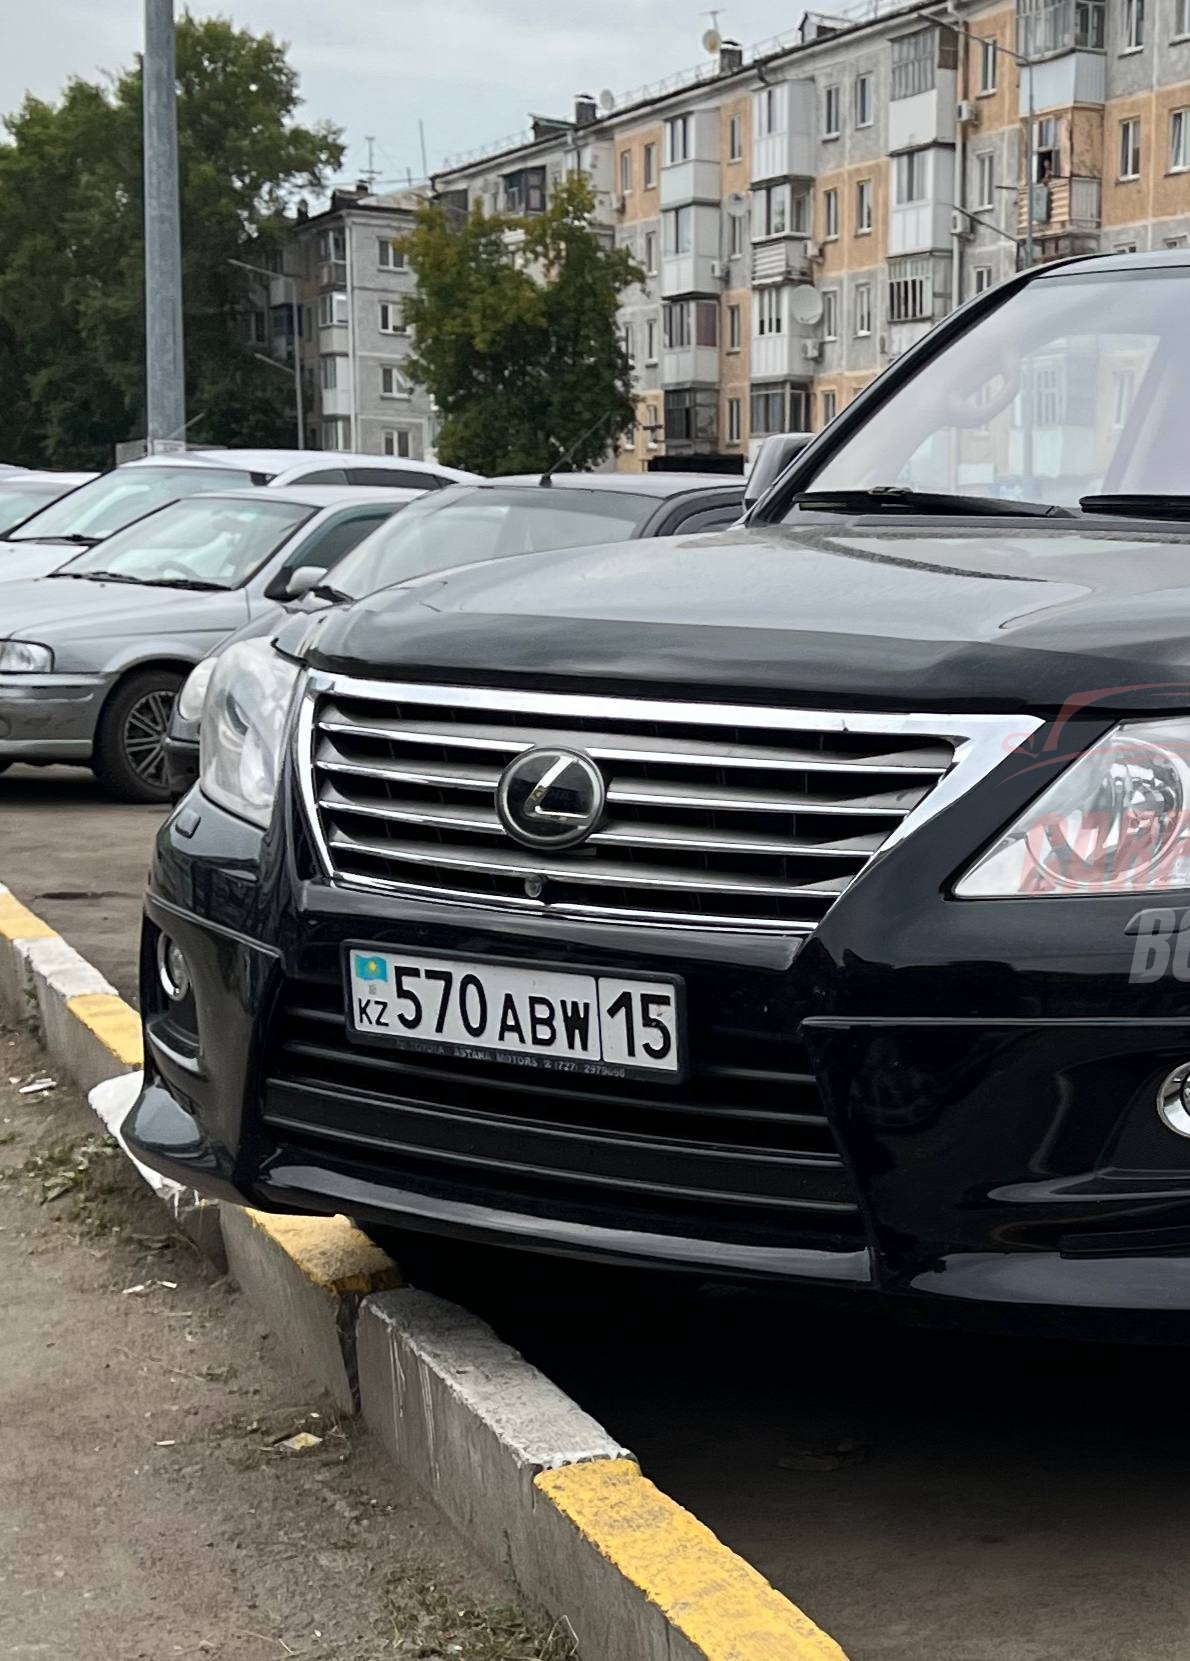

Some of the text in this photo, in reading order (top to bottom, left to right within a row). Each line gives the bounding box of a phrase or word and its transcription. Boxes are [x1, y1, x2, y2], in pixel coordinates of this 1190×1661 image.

[357, 998, 390, 1027] KZ
[394, 965, 488, 1038] 570
[606, 991, 672, 1060] 15
[496, 1052, 538, 1068] MOTORS
